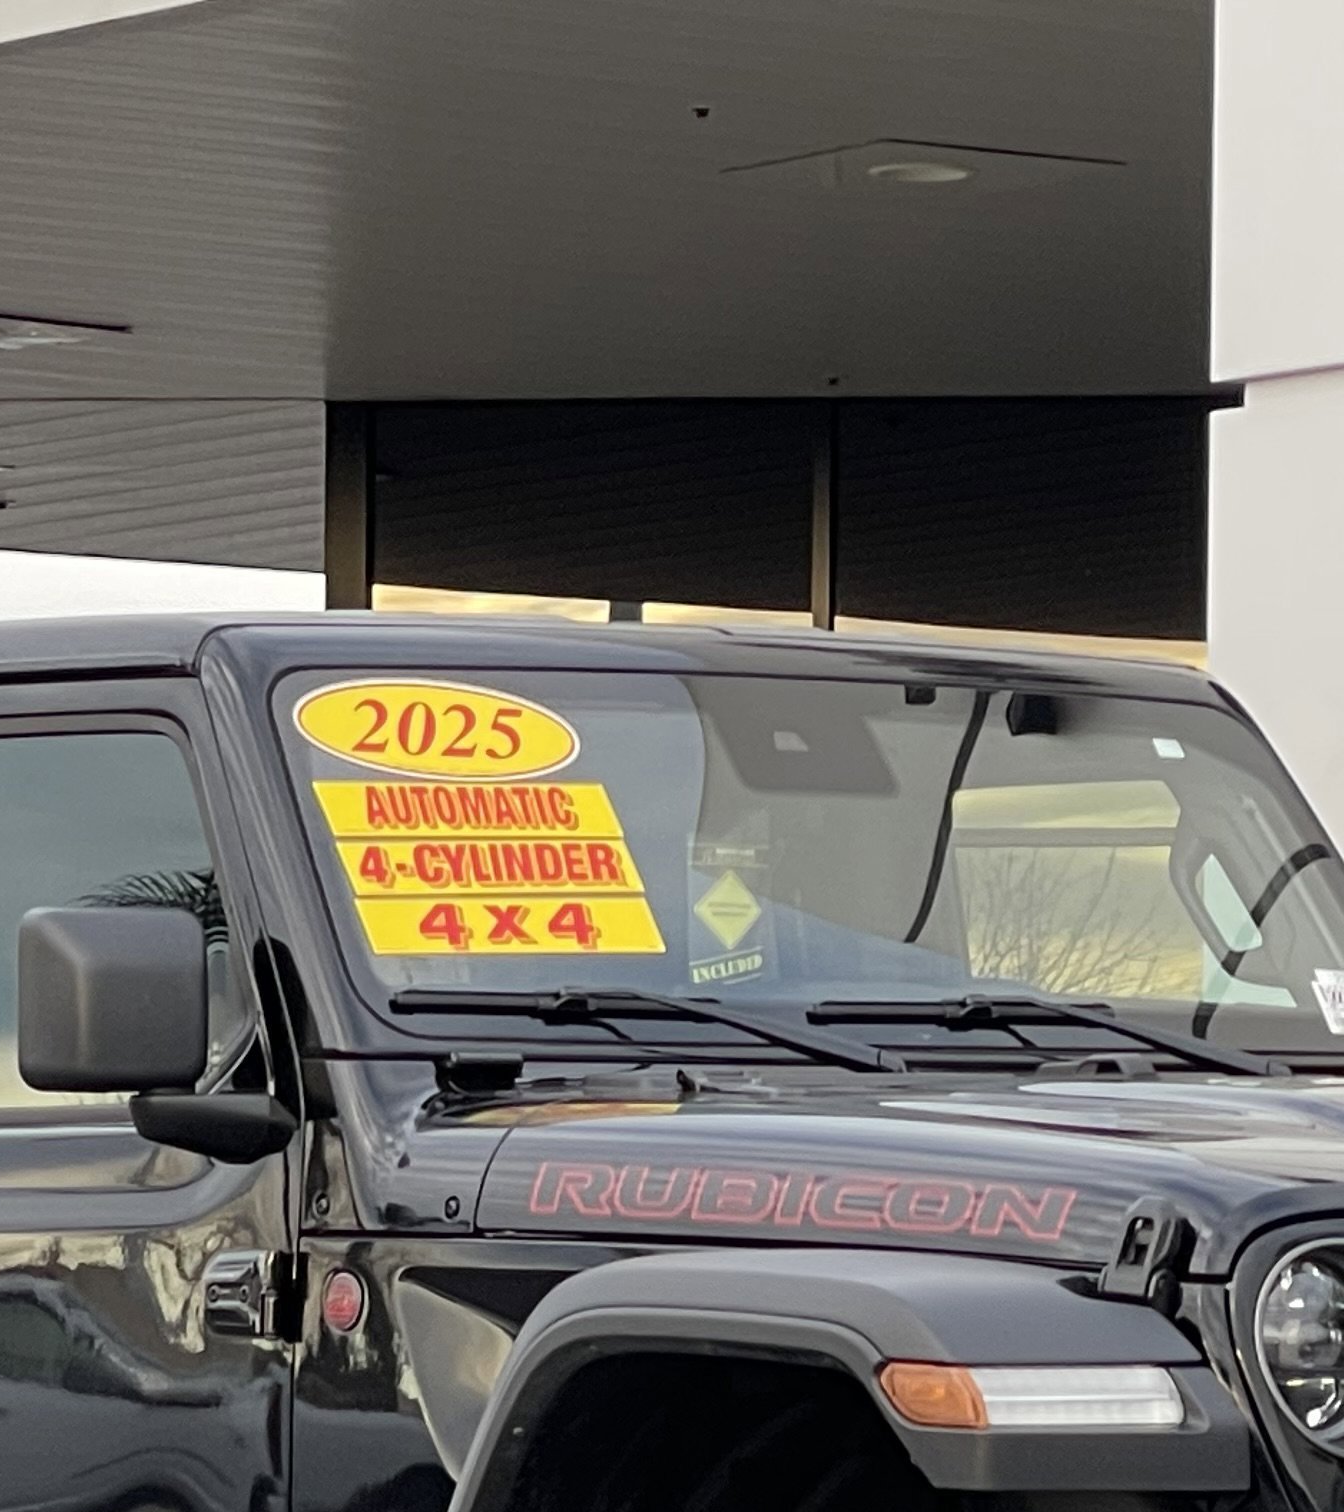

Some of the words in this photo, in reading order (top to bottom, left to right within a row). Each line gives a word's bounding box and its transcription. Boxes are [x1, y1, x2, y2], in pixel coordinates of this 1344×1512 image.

[352, 699, 524, 760] 2025
[366, 786, 580, 830] AUTOMATIC
[359, 842, 624, 889] 4-CYLINDER
[529, 1161, 1077, 1240] RUBICON
